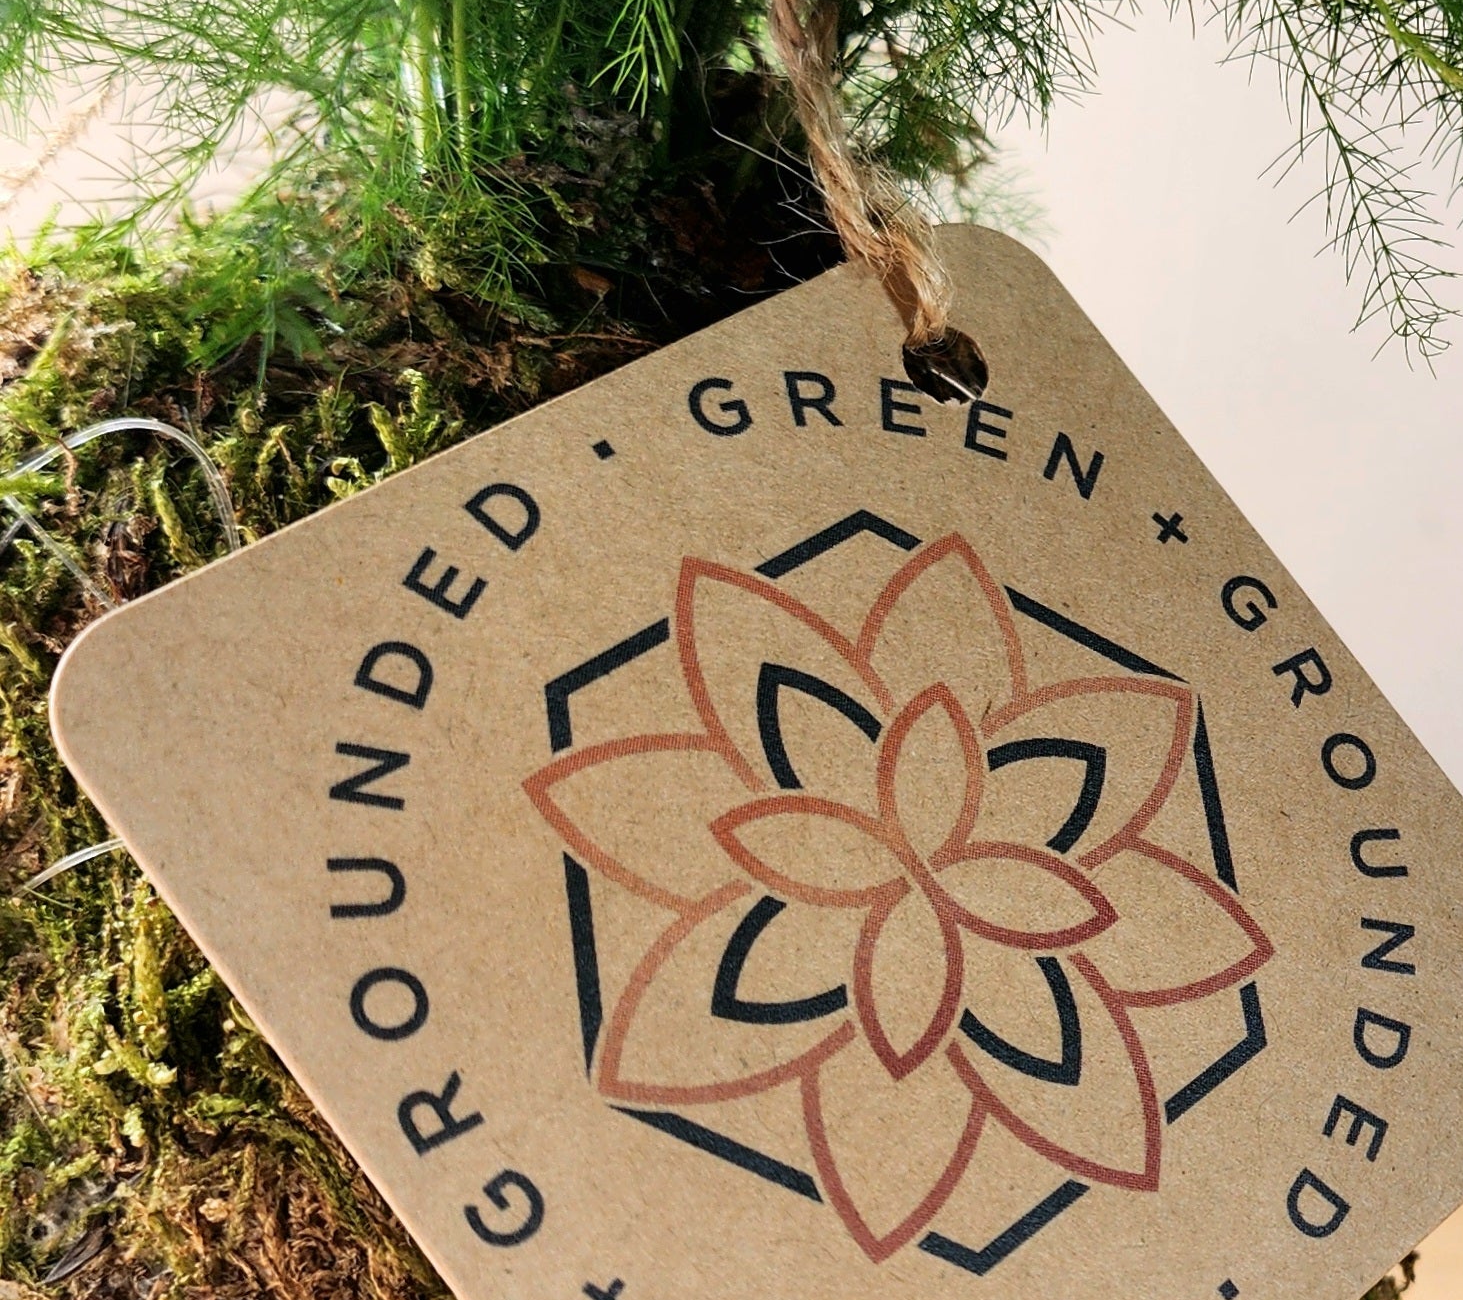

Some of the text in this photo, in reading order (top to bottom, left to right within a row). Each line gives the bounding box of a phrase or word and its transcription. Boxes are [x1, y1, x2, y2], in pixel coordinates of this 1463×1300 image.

[326, 482, 545, 1247] GROUNDED
[687, 370, 1105, 501] GREEN
[1220, 574, 1416, 1239] GROUNDED
